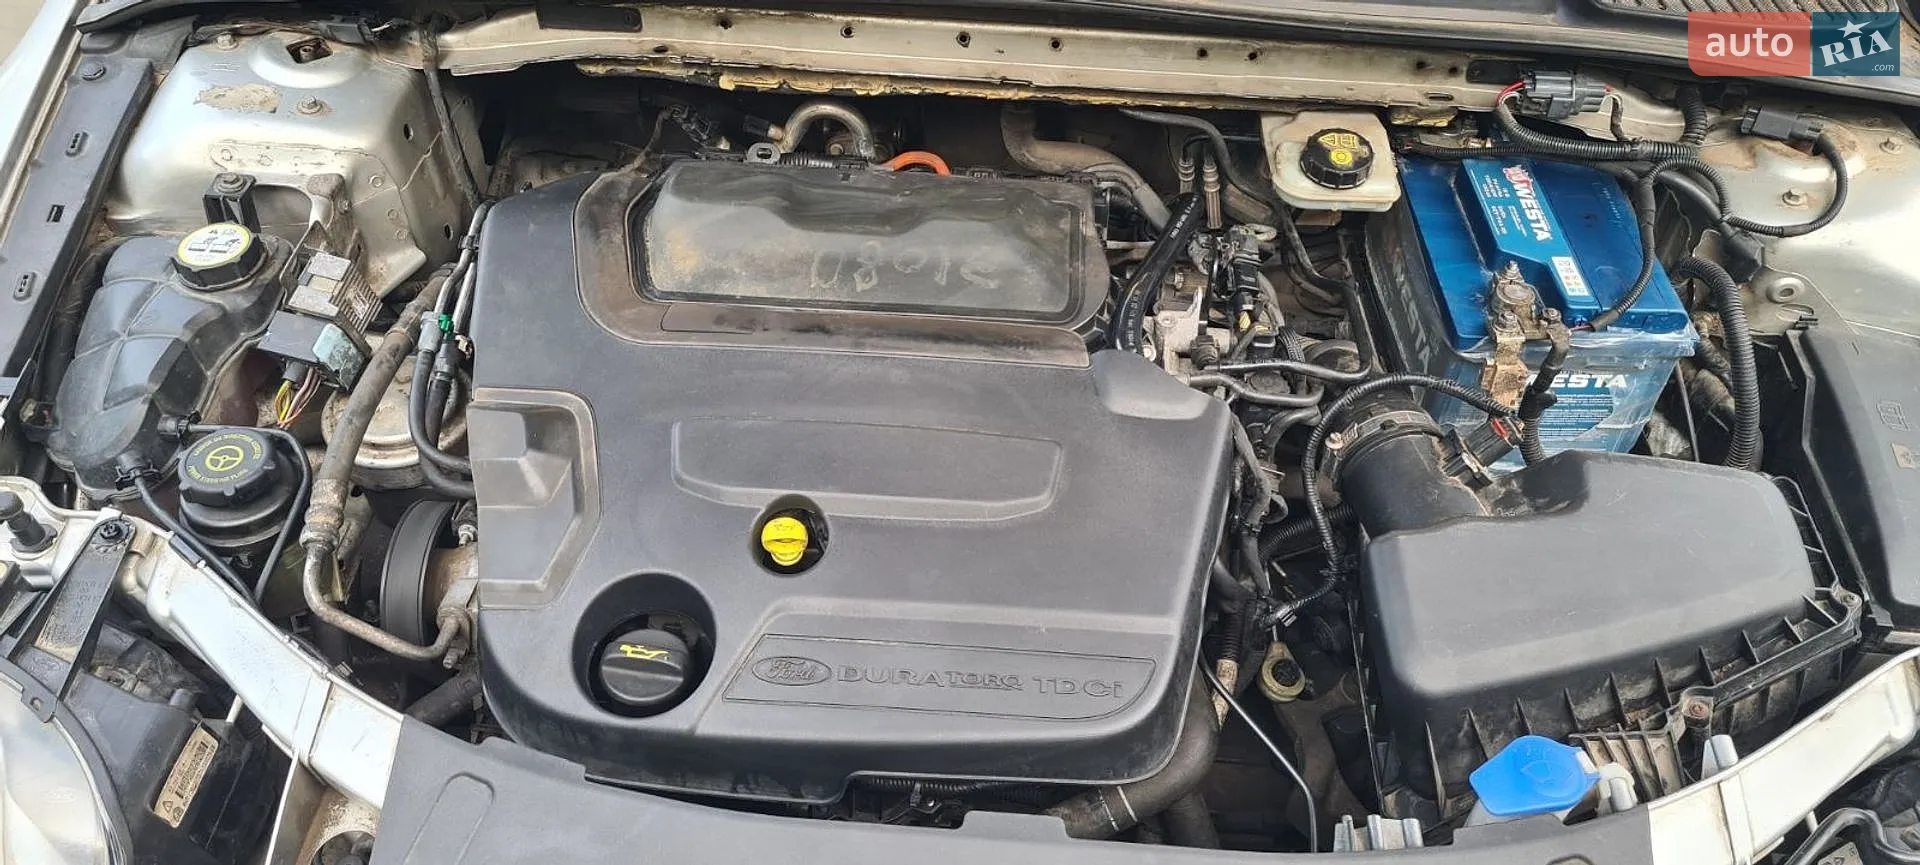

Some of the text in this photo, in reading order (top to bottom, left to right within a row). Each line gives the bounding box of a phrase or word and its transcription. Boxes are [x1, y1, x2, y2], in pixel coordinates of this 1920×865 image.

[1513, 183, 1553, 241] WESTA
[1526, 374, 1628, 388] ESTA
[761, 657, 822, 684] Ford
